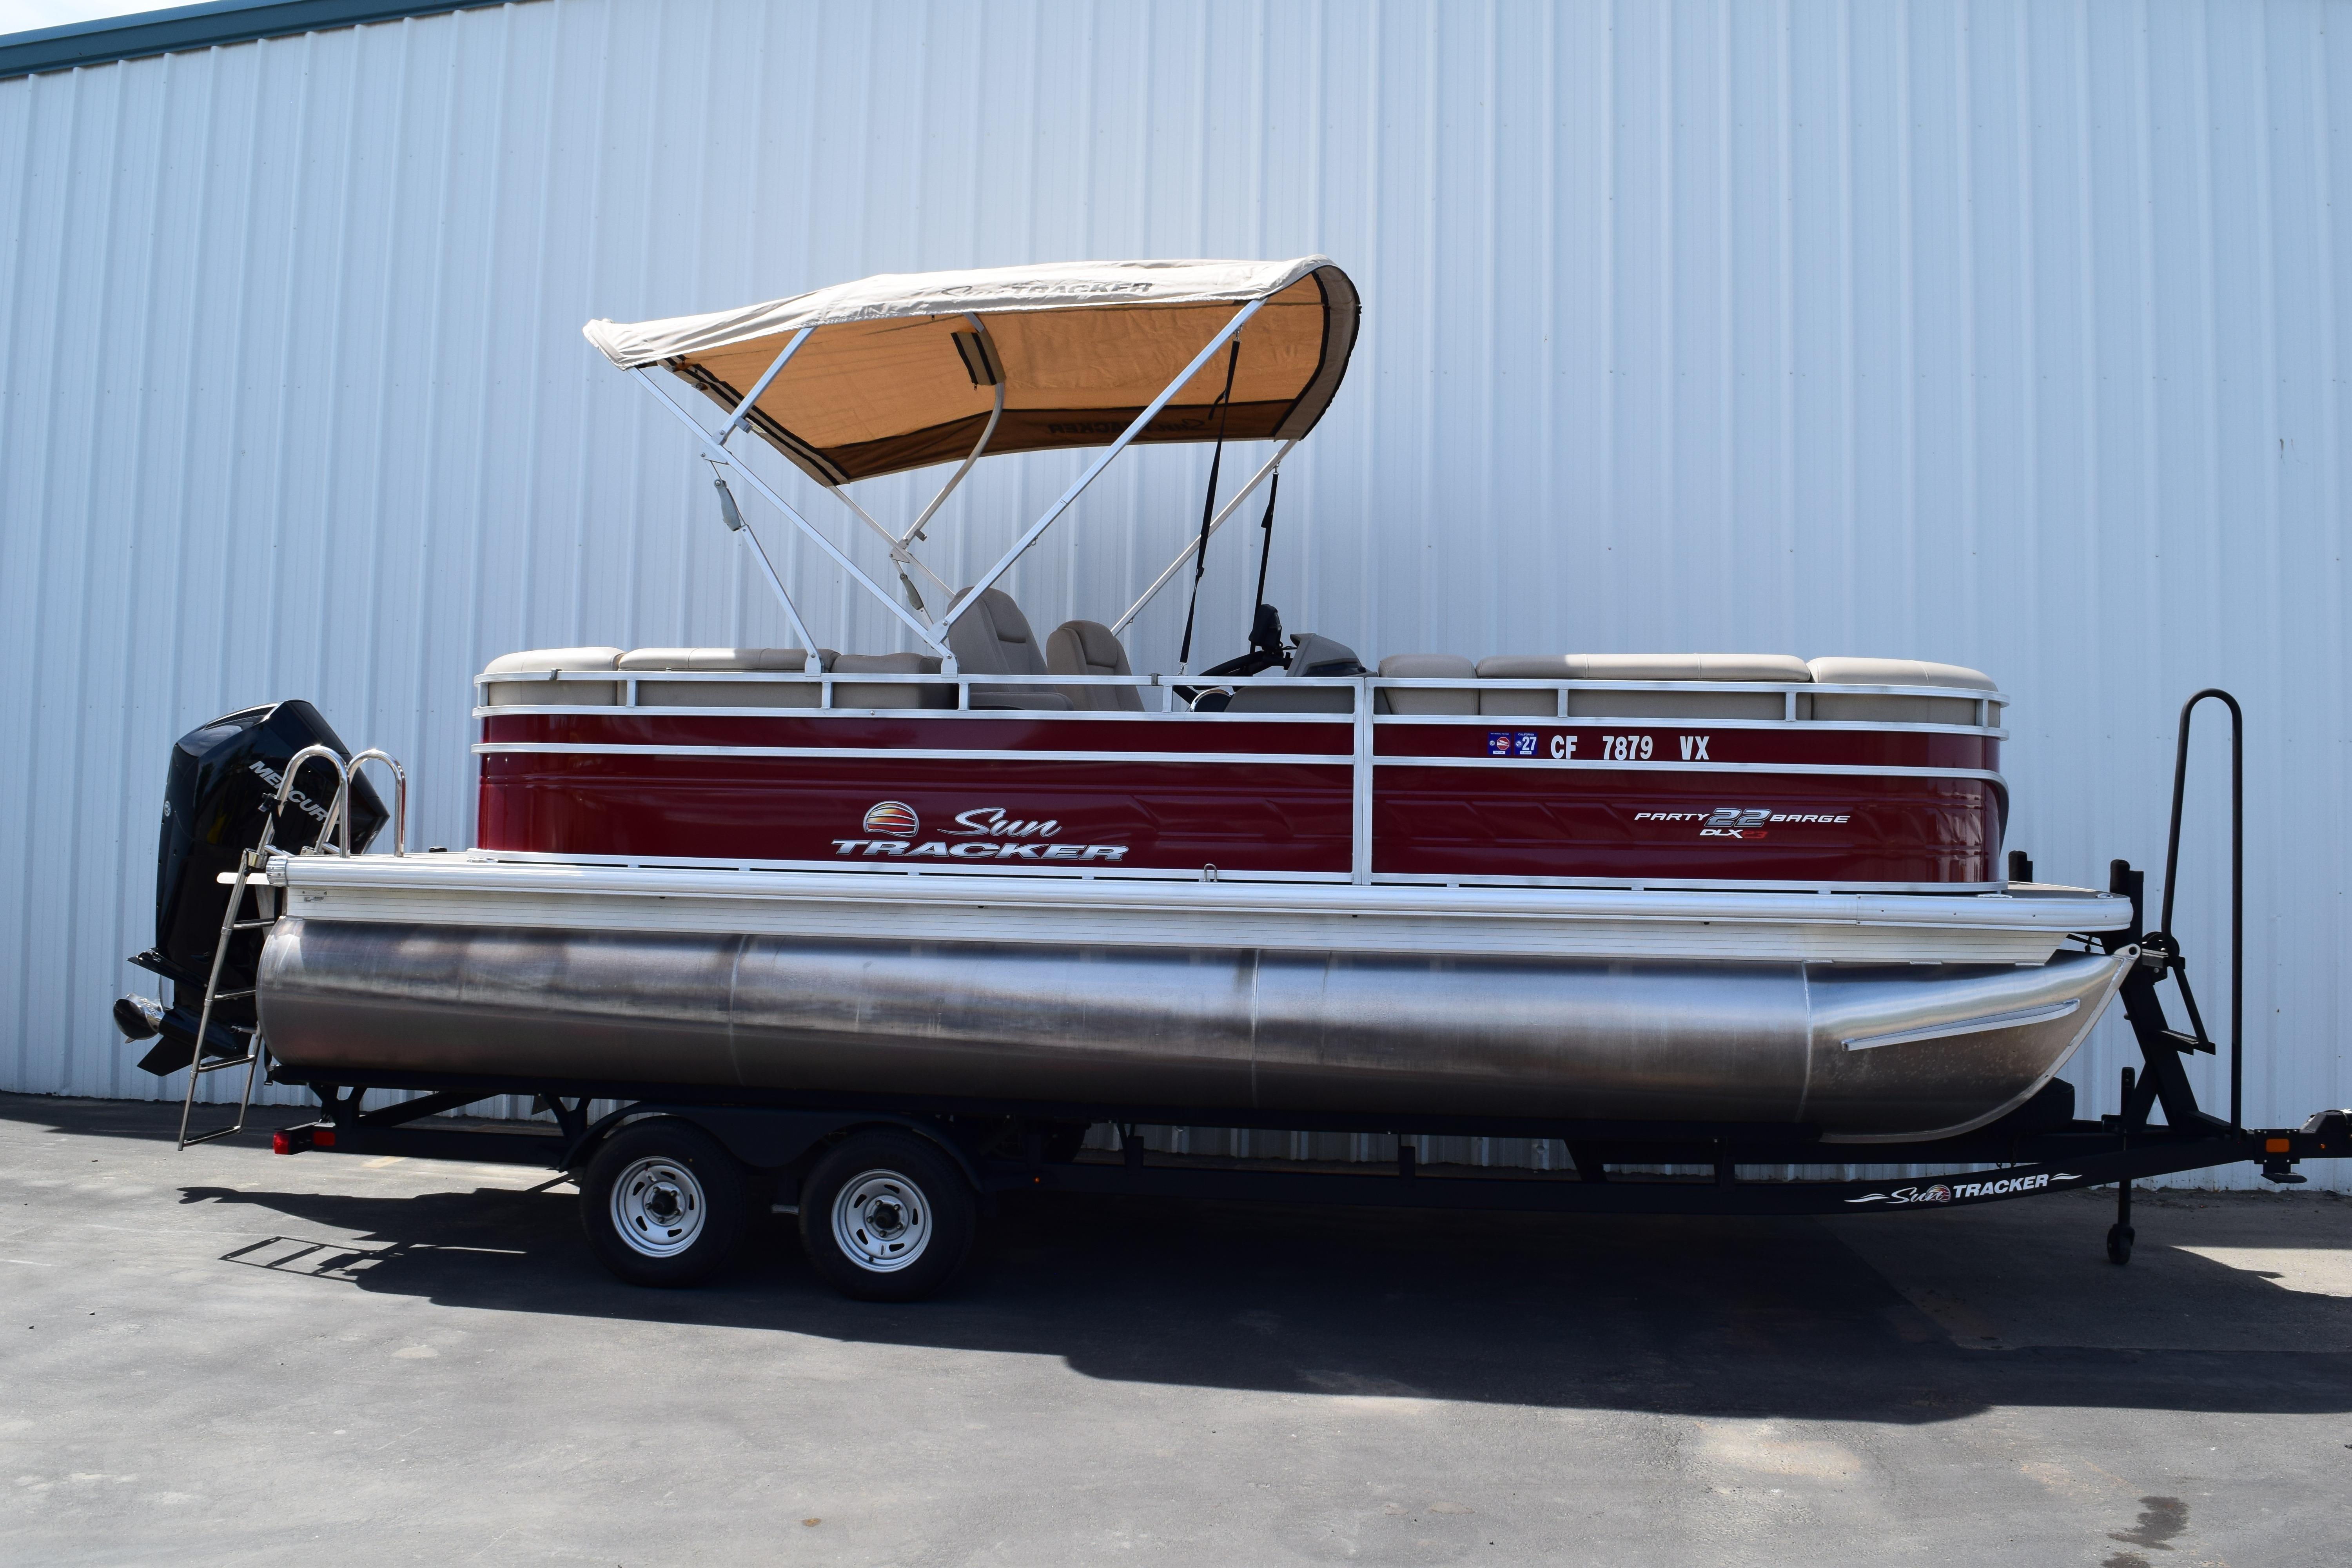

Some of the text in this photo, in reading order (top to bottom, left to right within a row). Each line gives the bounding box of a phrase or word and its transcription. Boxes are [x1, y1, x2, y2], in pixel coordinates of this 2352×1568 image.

[1011, 283, 1153, 294] TRACKER
[1522, 736, 1537, 750] 27
[1551, 735, 1710, 760] CF 7879 VX
[249, 761, 340, 824] MECUR
[937, 808, 1062, 837] Sun
[1704, 808, 1772, 828] 22
[1769, 814, 1851, 823] BARGE
[831, 839, 1129, 860] TRACKER
[1884, 1174, 2049, 1203] Sun TRACKER
